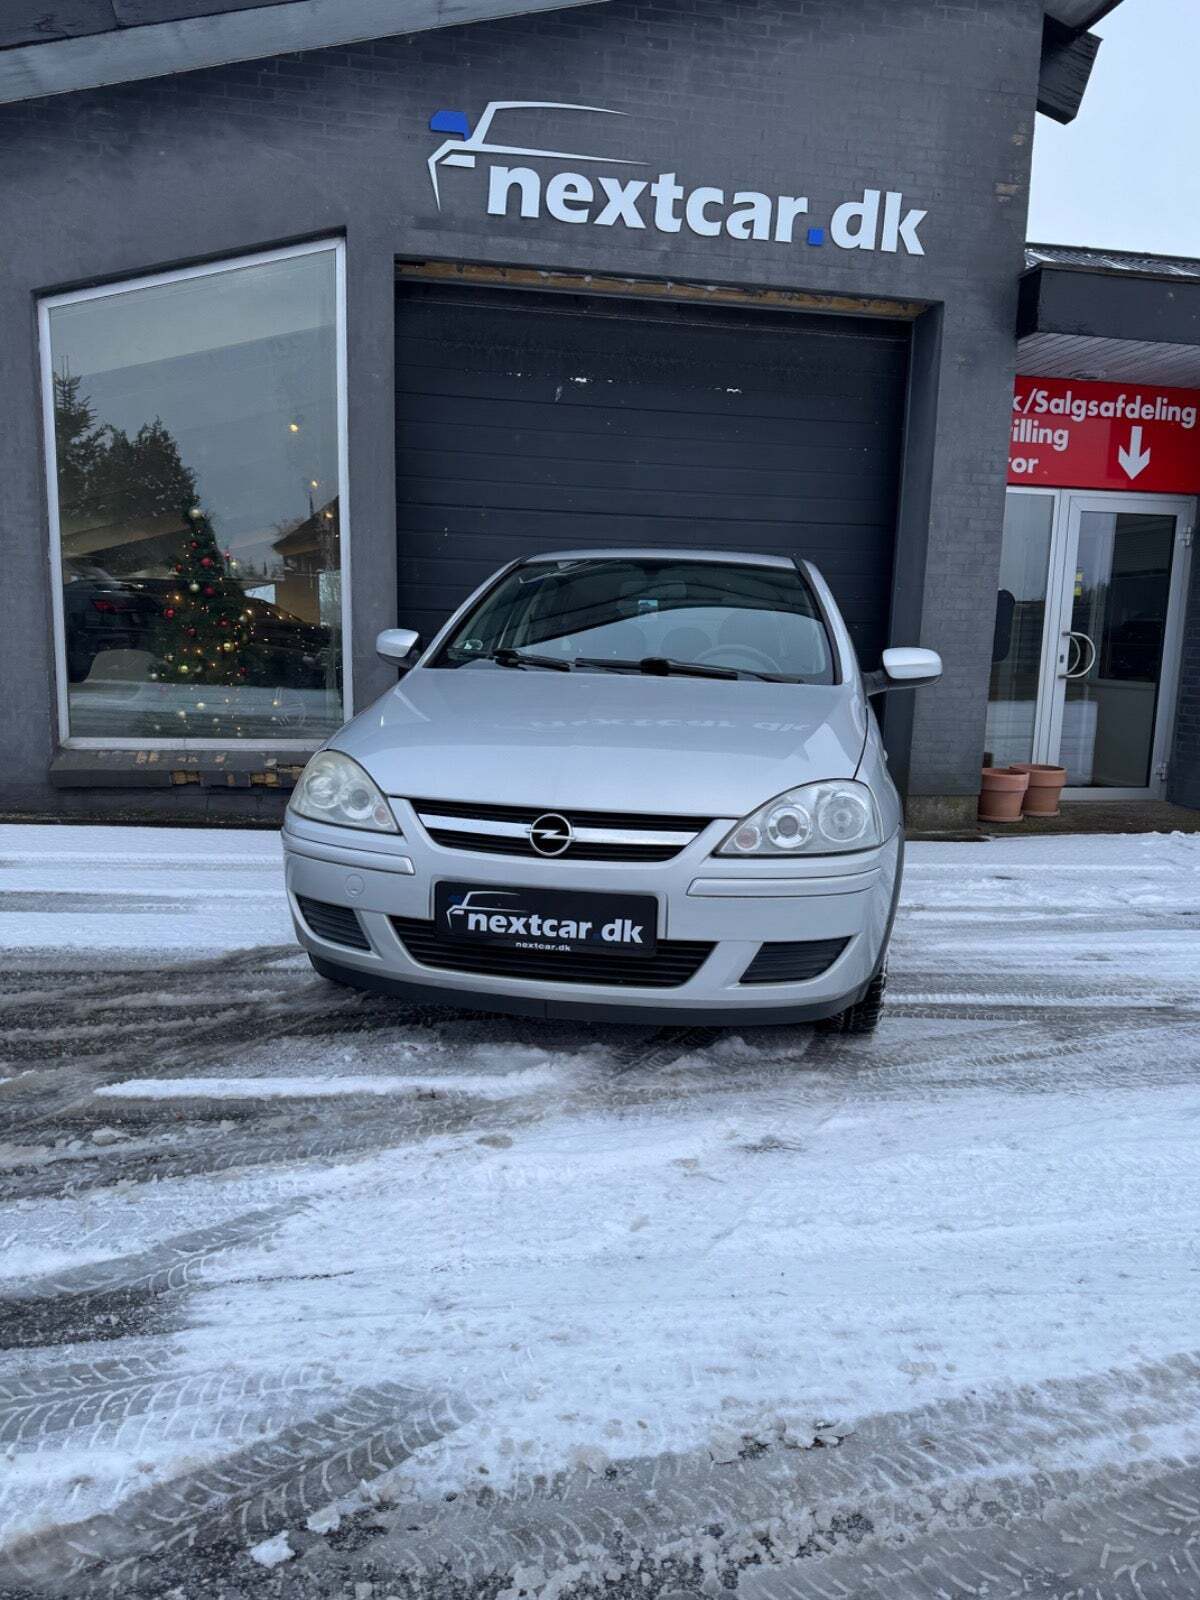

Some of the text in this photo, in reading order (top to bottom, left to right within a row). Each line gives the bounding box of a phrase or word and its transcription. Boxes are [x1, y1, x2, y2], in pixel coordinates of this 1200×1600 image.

[487, 164, 928, 256] nextcar.dk
[1011, 418, 1069, 452] illing
[1008, 457, 1040, 474] or
[515, 941, 571, 952] nextcar.dk
